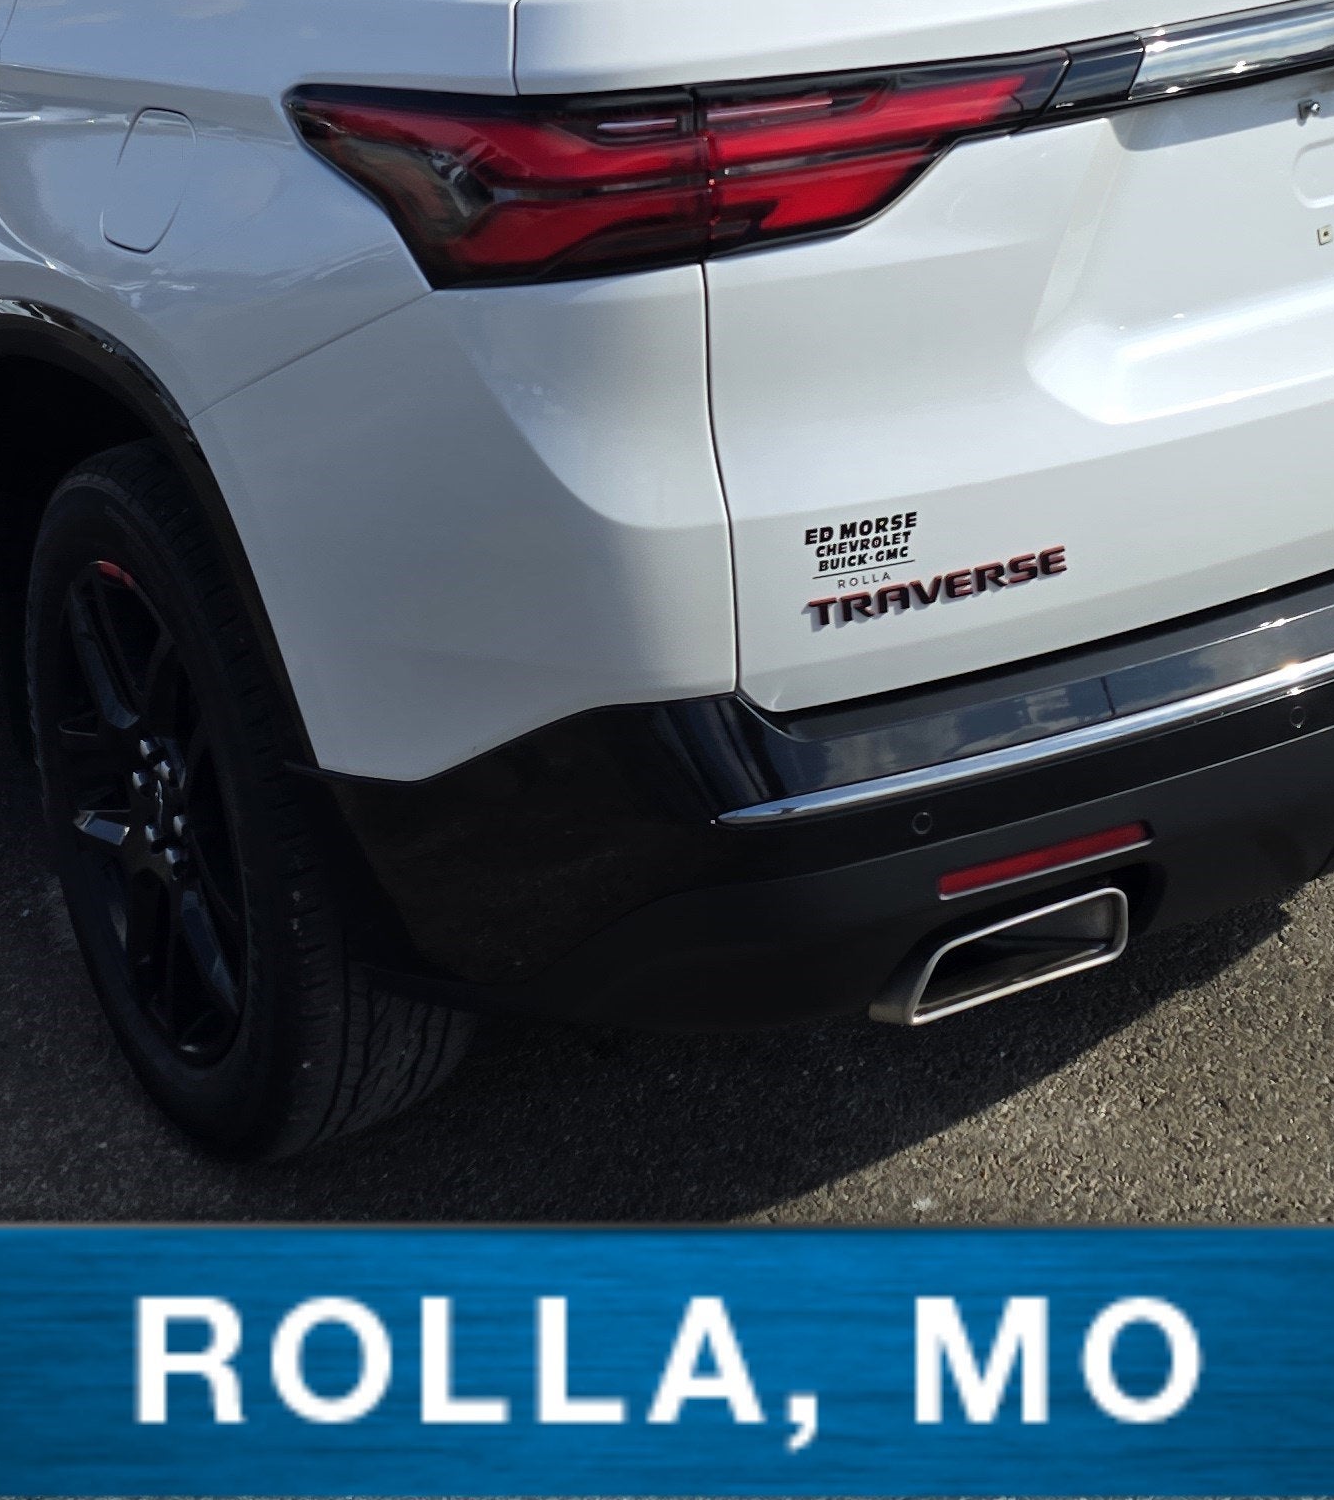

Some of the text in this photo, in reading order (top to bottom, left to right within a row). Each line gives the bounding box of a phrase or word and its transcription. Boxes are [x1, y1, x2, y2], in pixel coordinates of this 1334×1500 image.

[804, 510, 918, 546] ED MORSE
[815, 530, 913, 559] CHEVROLET
[807, 544, 1068, 627] TRAVERSE
[836, 571, 892, 590] ROLLA
